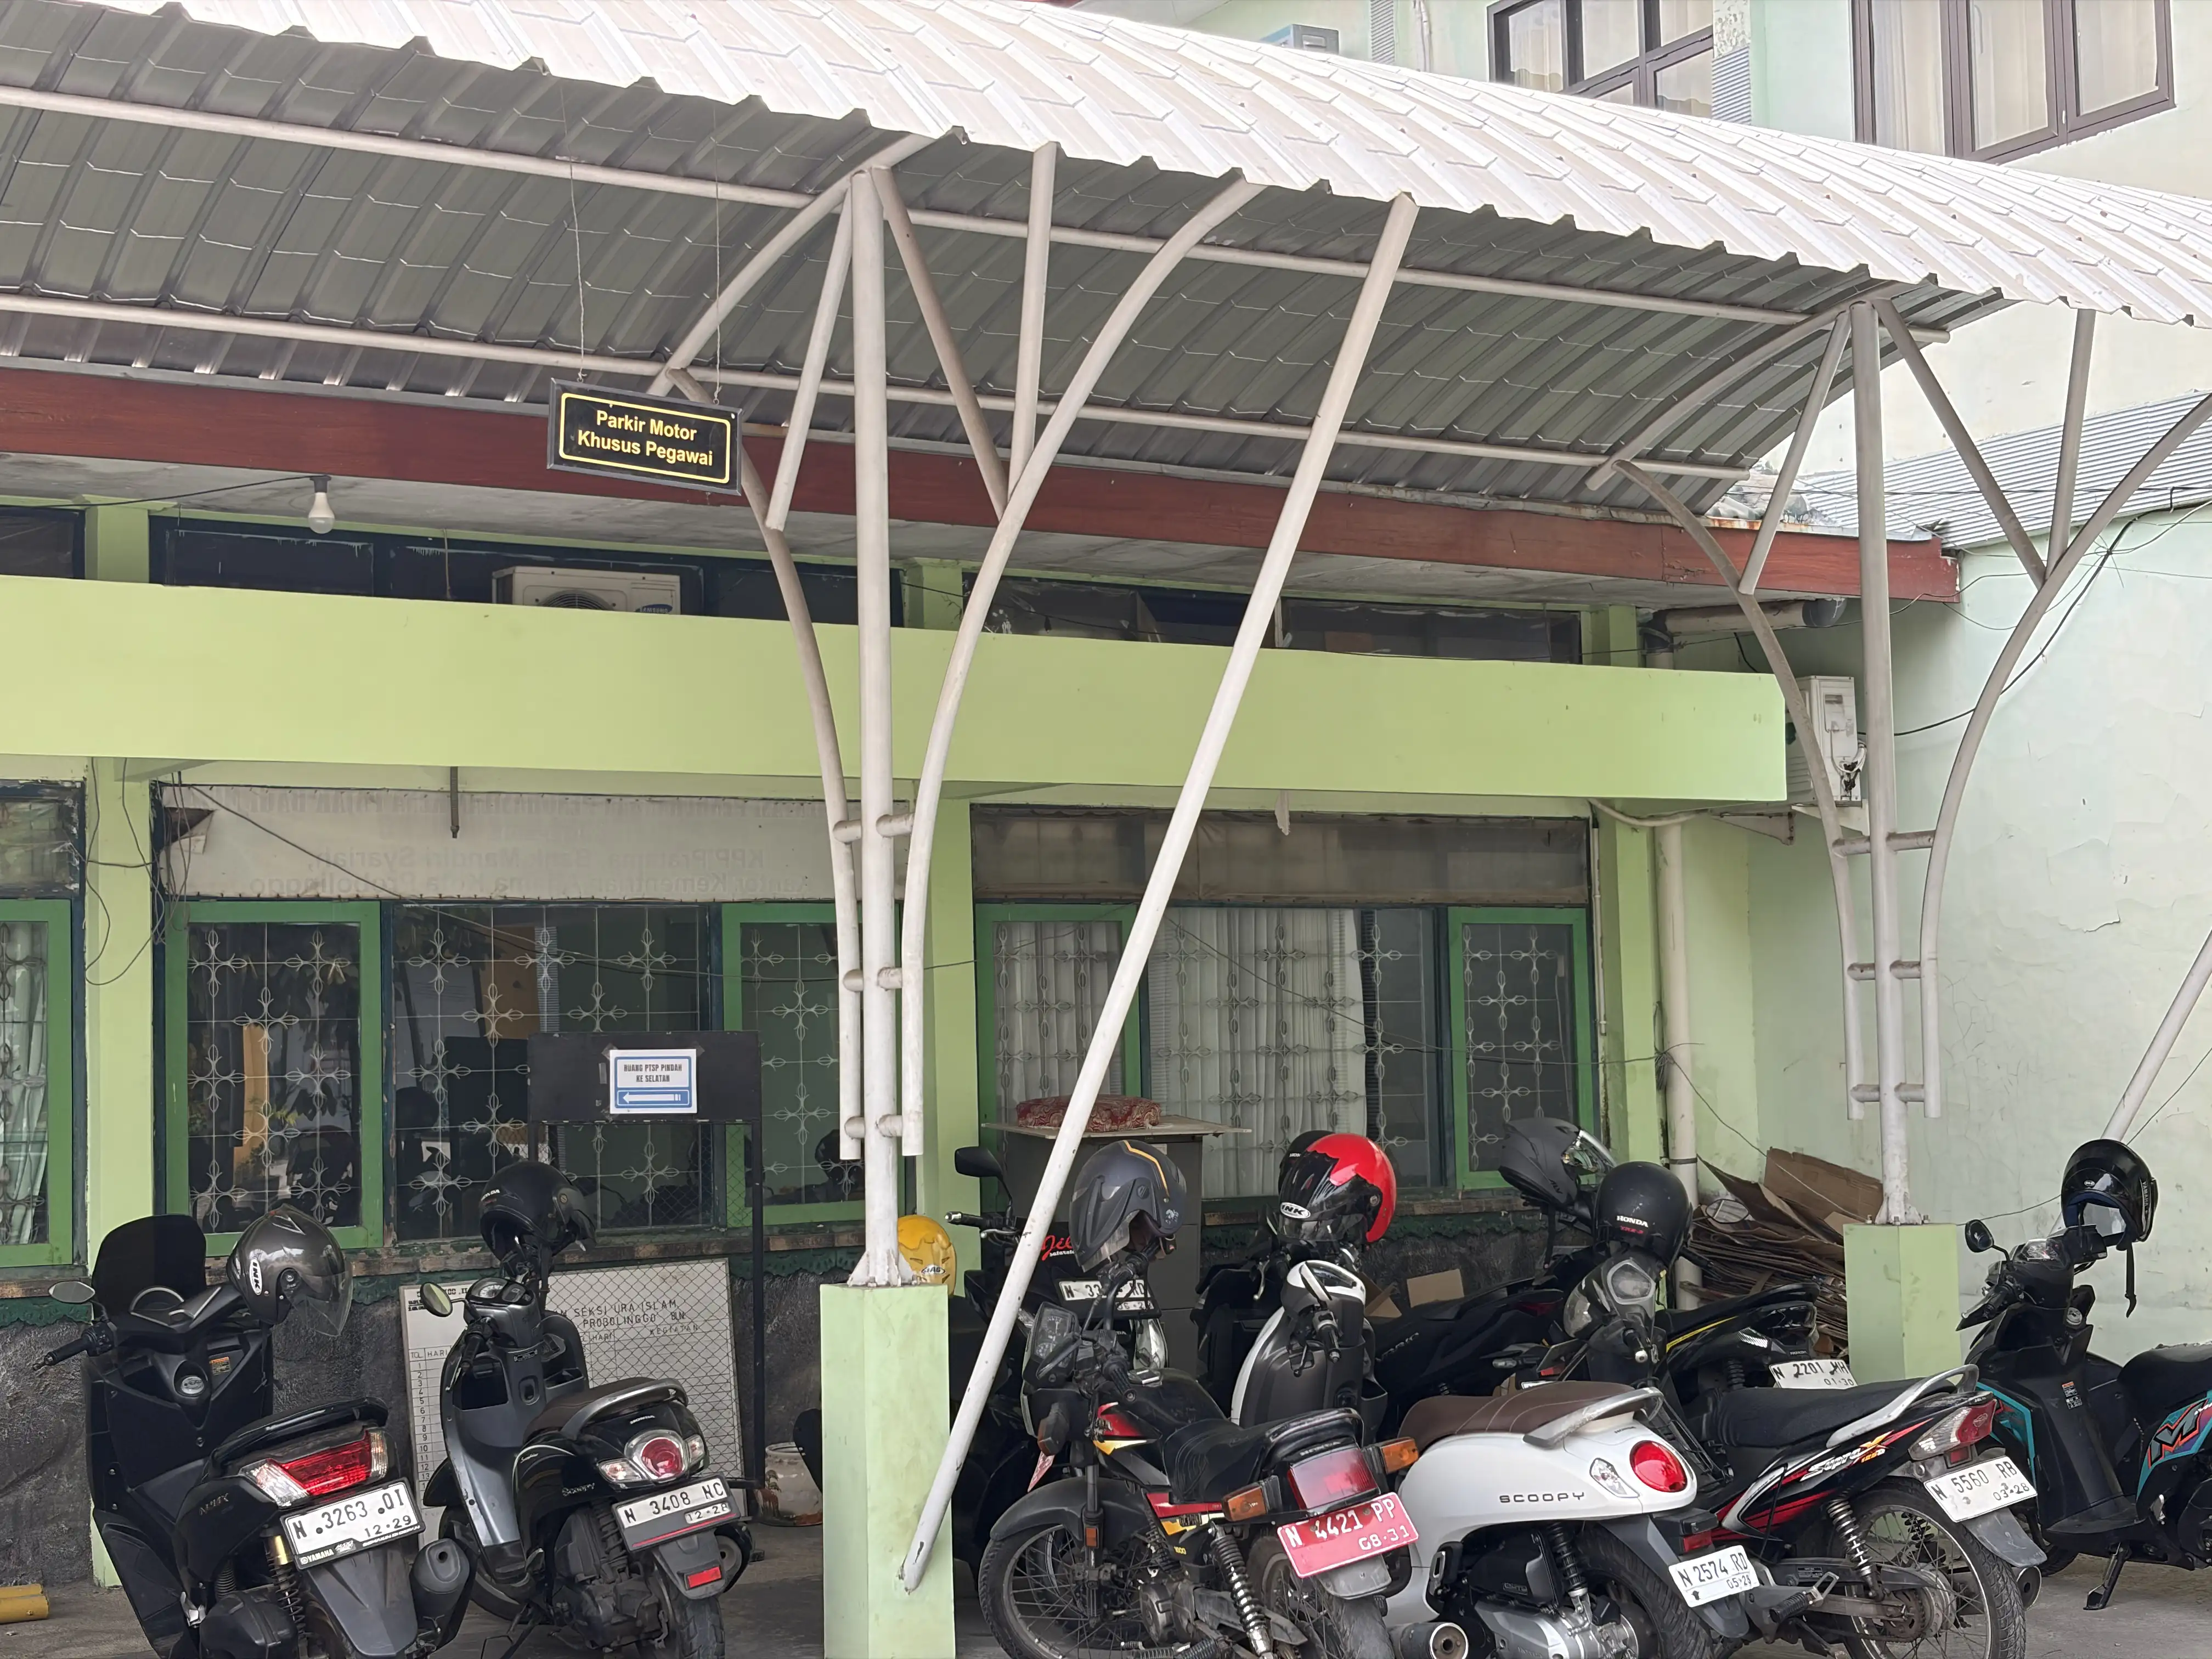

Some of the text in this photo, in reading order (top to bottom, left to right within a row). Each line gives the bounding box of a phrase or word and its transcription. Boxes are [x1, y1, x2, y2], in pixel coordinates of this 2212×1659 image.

[597, 410, 697, 441] Parkir Motor
[578, 430, 713, 466] Khusus Pegawai
[661, 1064, 682, 1072] PINDAH
[1282, 1204, 1306, 1216] INK
[1617, 1215, 1649, 1228] HONDA
[252, 1262, 261, 1290] INK
[1064, 1285, 1075, 1298] N
[574, 1306, 607, 1317] SEKSI
[614, 1302, 635, 1313] URA
[642, 1300, 676, 1312] ISLAM
[583, 1313, 656, 1328] PROBOLINGGO
[650, 1324, 699, 1335] KEGIATAN
[1773, 1366, 1785, 1380] N
[1793, 1362, 1824, 1376] 2201
[1799, 1447, 1862, 1482] Supra
[1931, 1461, 2018, 1501] N 5560 RB
[624, 1482, 724, 1524] N 3408 NC
[1499, 1491, 1585, 1504] SCOOPY
[292, 1520, 307, 1539] N
[321, 1500, 368, 1529] 3263
[1285, 1498, 1396, 1548] N 4421 PP
[308, 1548, 335, 1562] YAMAHA
[1678, 1552, 1748, 1587] N 2574 RD
